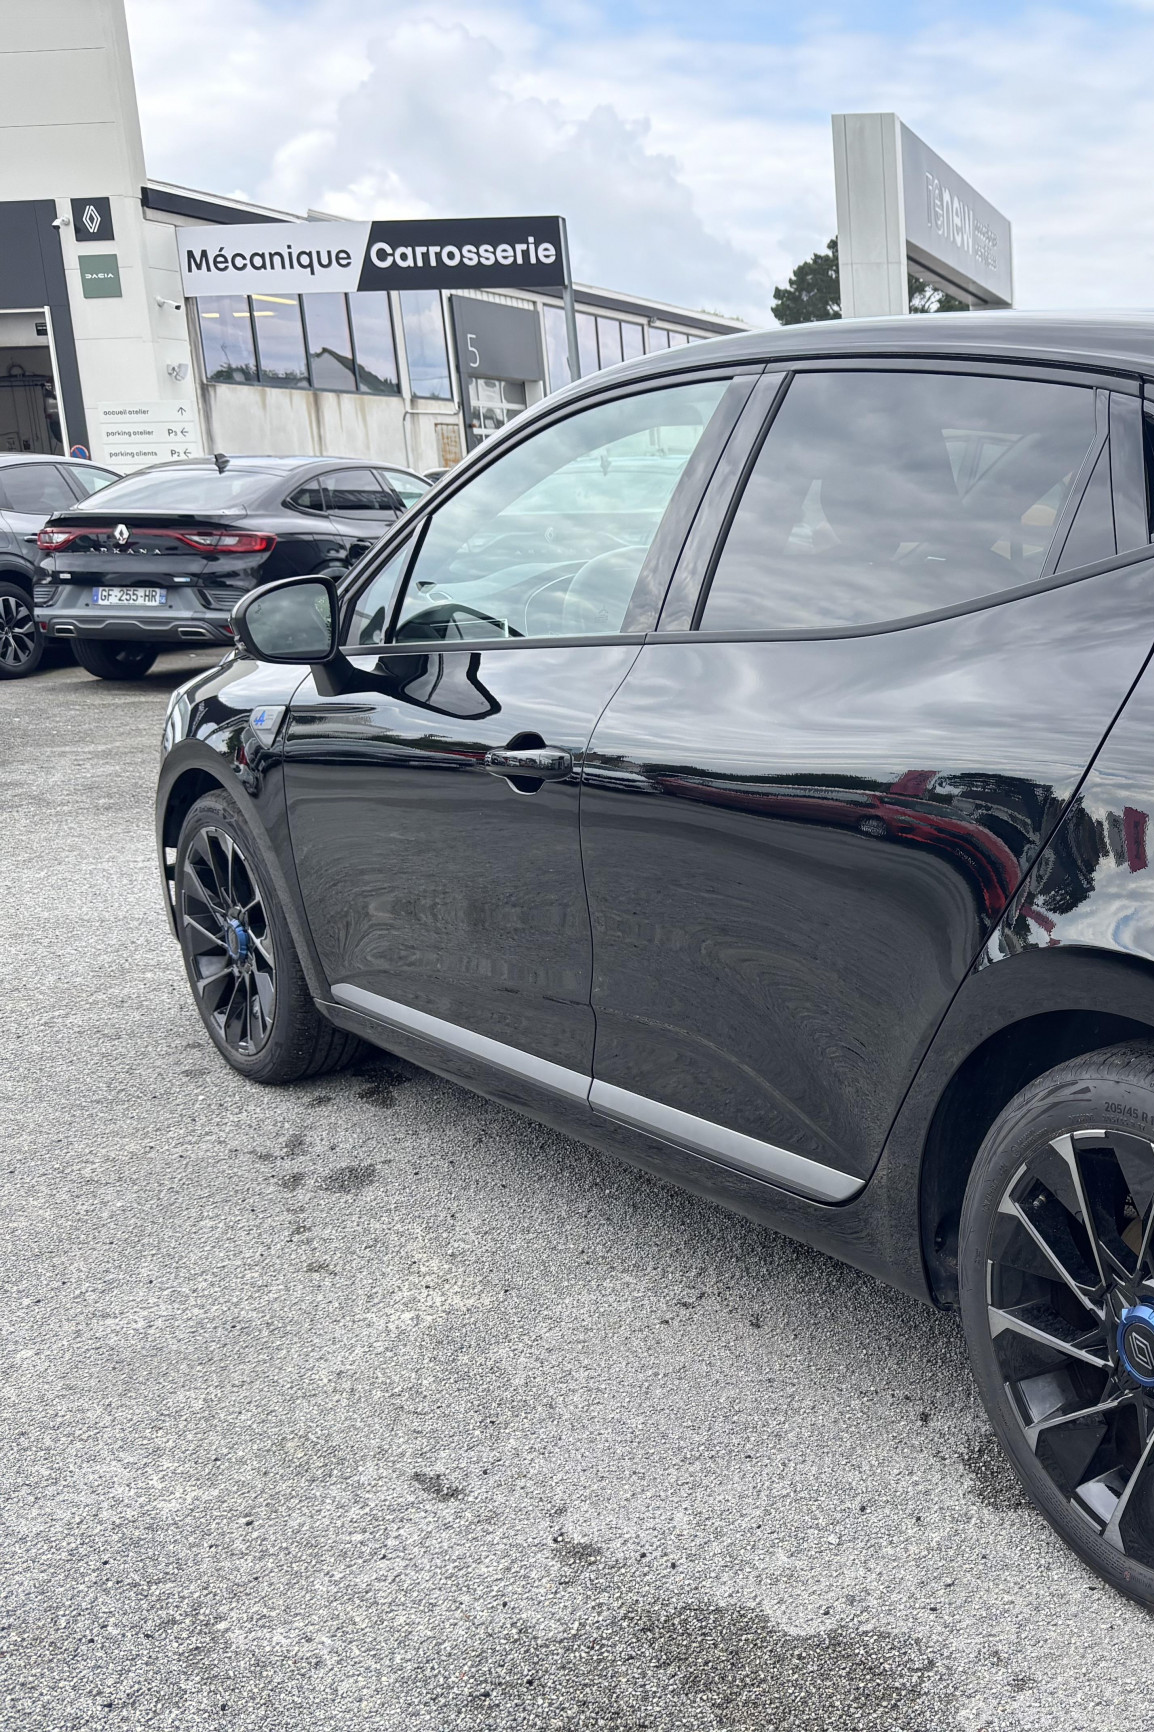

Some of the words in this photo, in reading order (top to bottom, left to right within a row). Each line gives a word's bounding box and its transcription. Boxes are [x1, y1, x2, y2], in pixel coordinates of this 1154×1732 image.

[925, 172, 973, 255] renew
[186, 244, 352, 276] Mécanique
[370, 236, 557, 268] Carrosserie
[467, 334, 480, 368] 5
[106, 430, 132, 438] parking
[109, 451, 135, 459] parking
[170, 449, 181, 458] P2
[100, 588, 158, 603] GF-255-HR
[1104, 1101, 1139, 1119] 205/45
[1141, 1111, 1148, 1123] R
